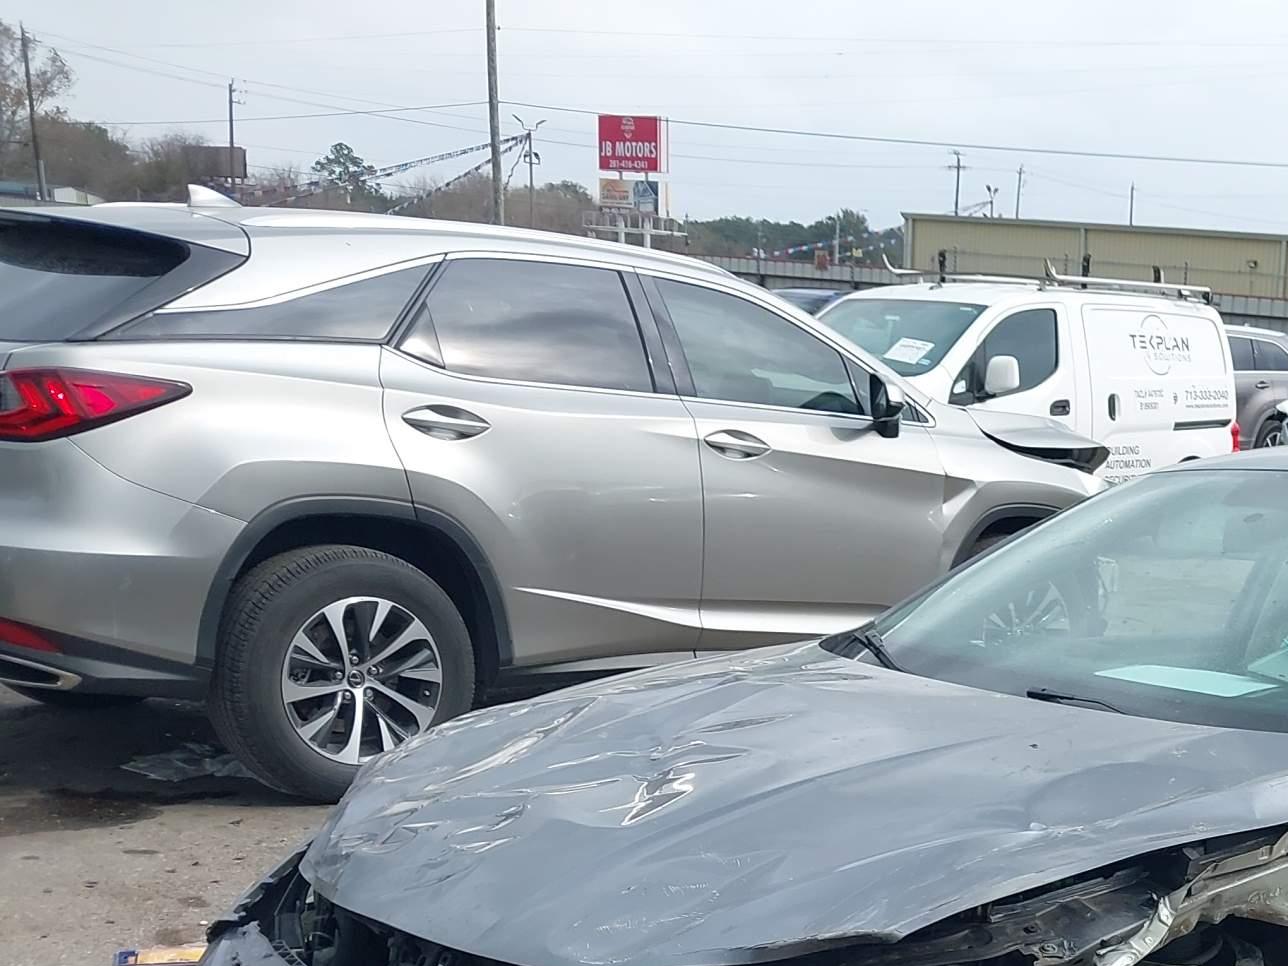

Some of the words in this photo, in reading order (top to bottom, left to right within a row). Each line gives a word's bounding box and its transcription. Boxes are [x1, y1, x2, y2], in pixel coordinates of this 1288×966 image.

[601, 140, 612, 156] JB
[615, 140, 657, 158] MOTORS
[1129, 334, 1190, 352] TEKPLAN
[1105, 459, 1151, 469] AUTOMATION
